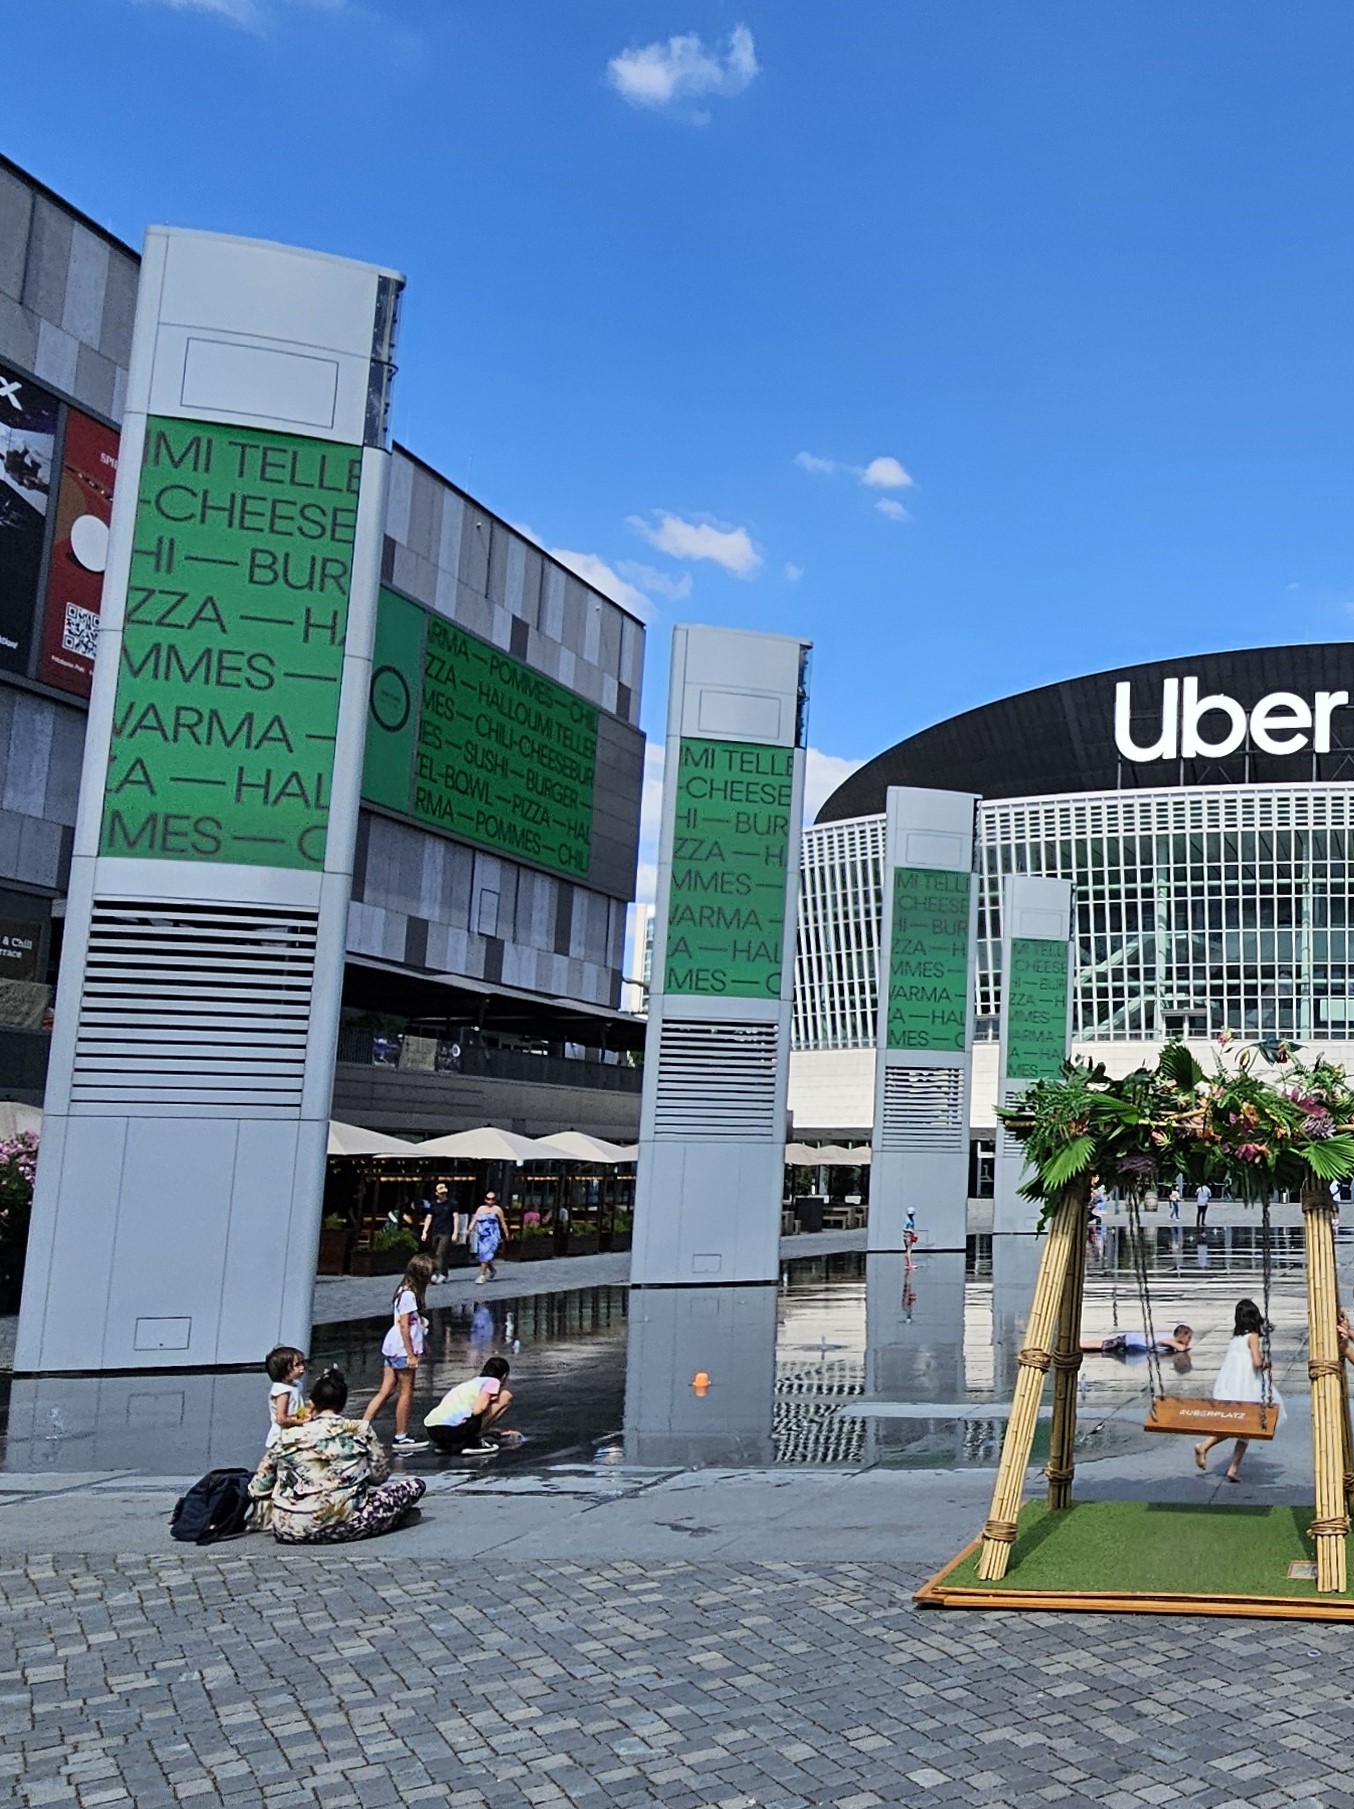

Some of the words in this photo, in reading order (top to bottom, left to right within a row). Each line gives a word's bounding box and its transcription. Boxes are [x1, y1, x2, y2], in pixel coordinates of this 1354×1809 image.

[247, 547, 348, 595] BUR
[126, 586, 227, 634] ZZA
[302, 606, 346, 646] H
[1115, 676, 1349, 762] Uber
[464, 740, 509, 778] SUSHI
[526, 768, 578, 809] BURGER
[107, 809, 223, 855] MES
[476, 810, 541, 856] POMMES
[513, 794, 552, 829] PIZZA
[735, 811, 788, 837] BUR
[667, 968, 727, 992] MES
